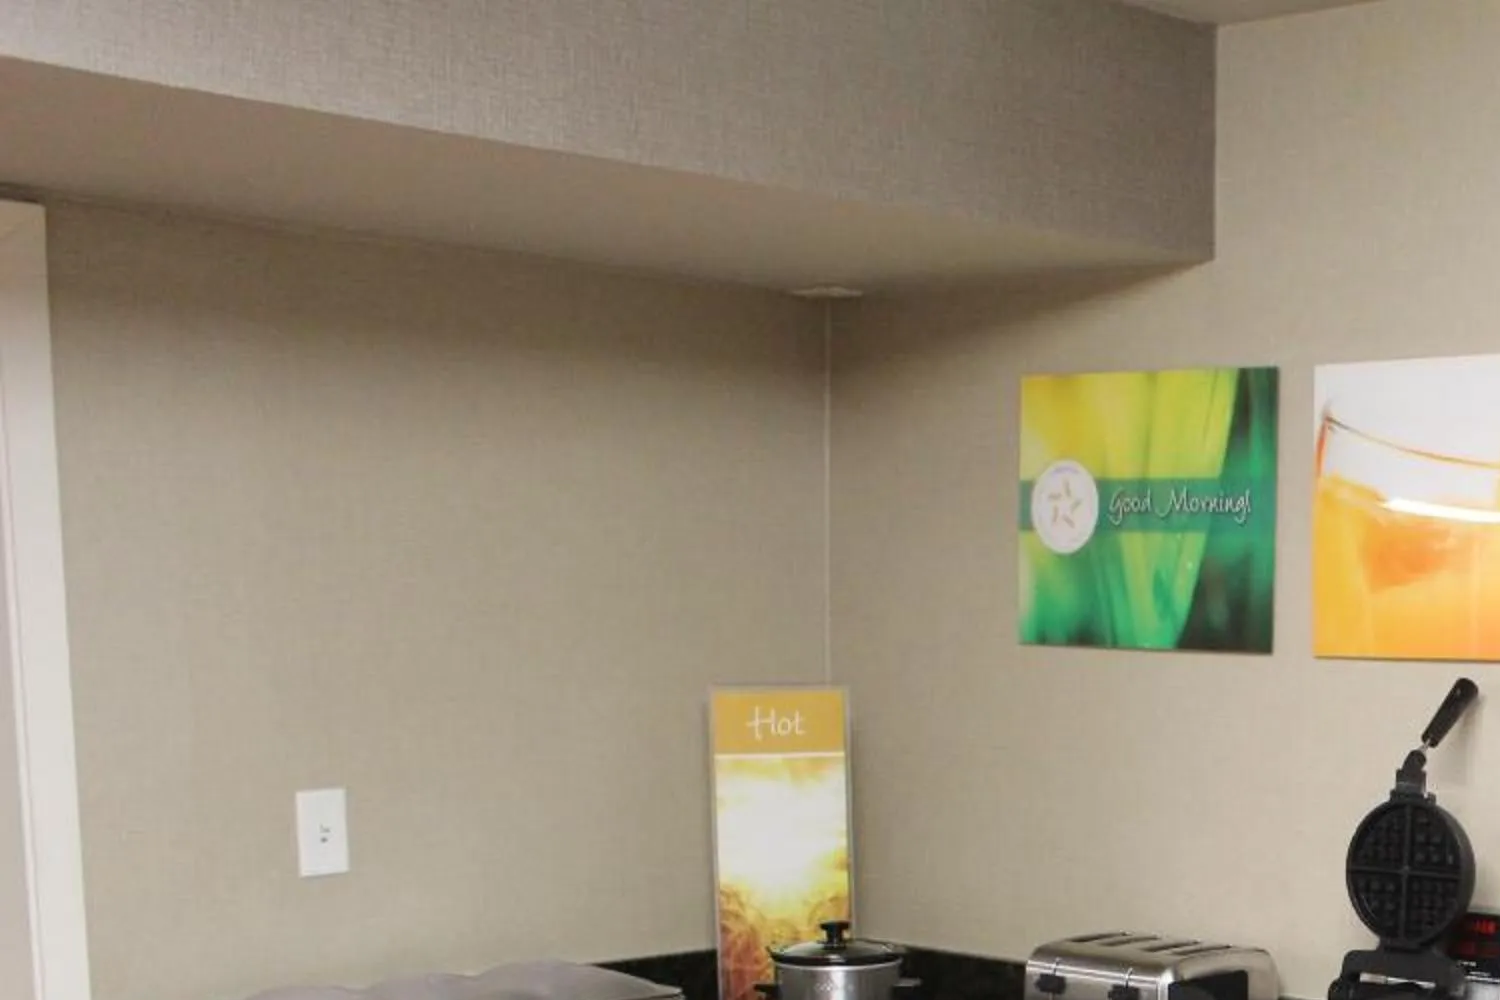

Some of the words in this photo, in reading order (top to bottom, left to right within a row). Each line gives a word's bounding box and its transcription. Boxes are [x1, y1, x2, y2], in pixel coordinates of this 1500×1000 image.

[1108, 486, 1152, 526] Good
[1154, 485, 1251, 524] Morning!
[746, 705, 806, 741] Hot
